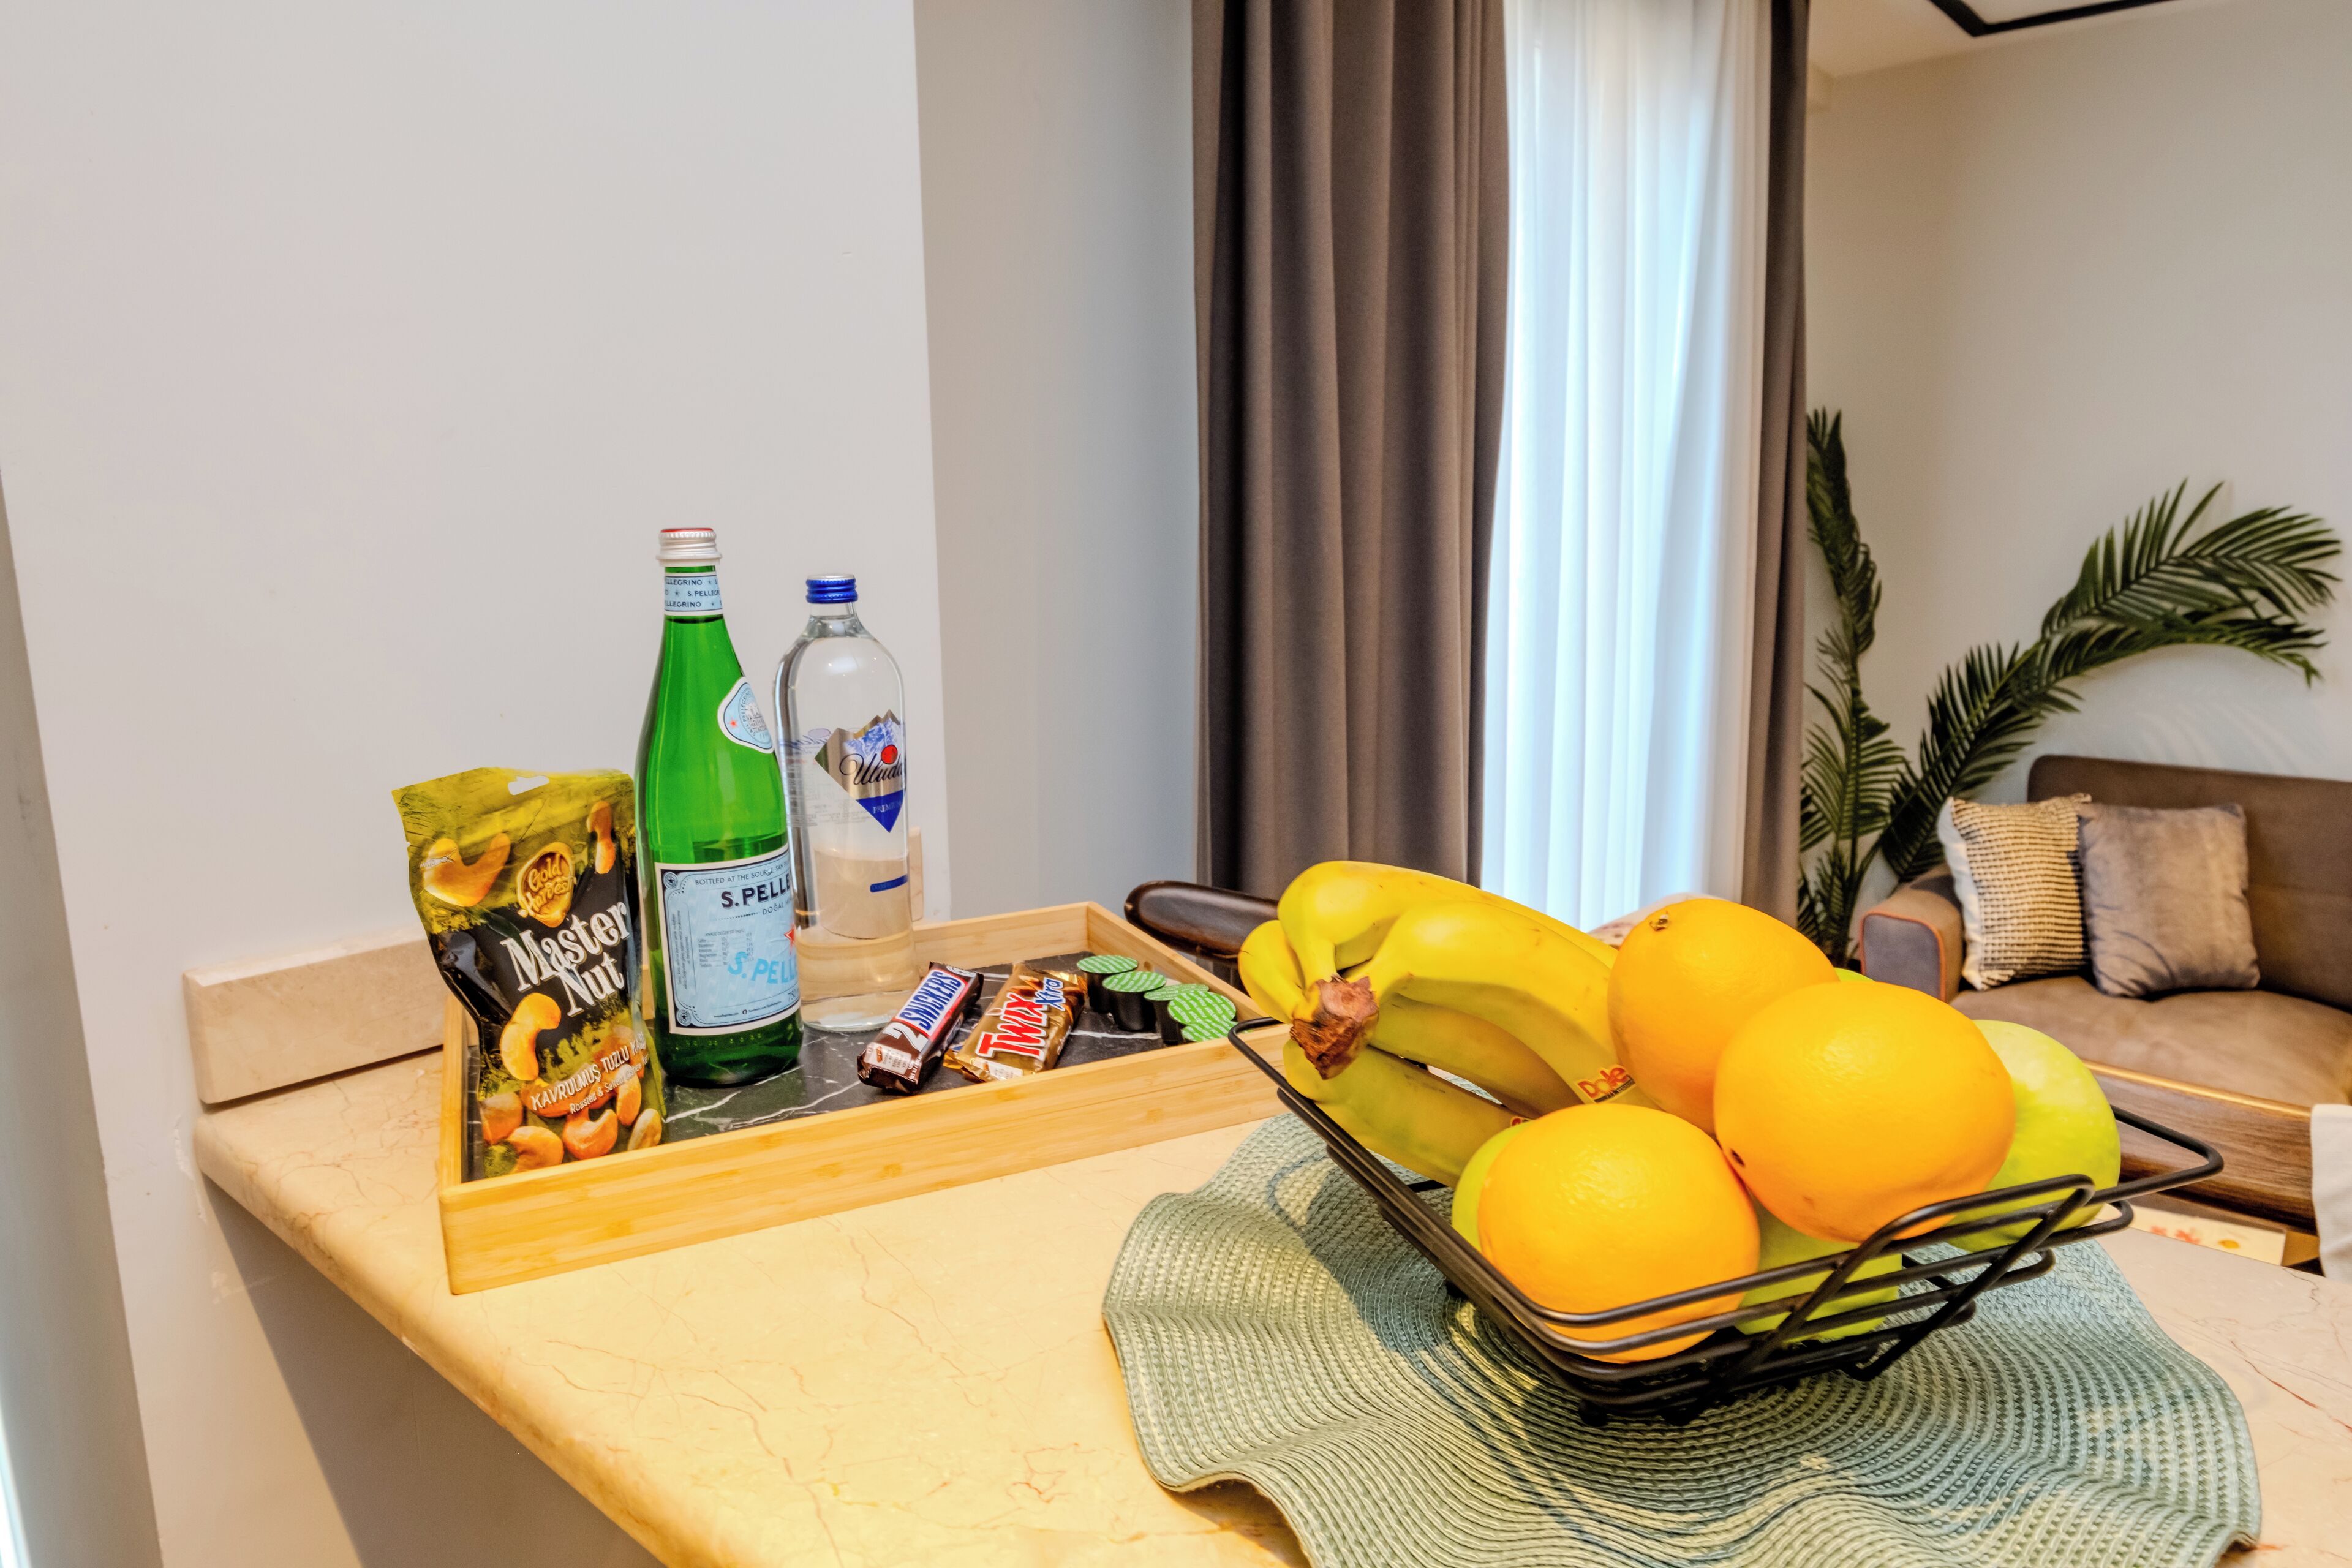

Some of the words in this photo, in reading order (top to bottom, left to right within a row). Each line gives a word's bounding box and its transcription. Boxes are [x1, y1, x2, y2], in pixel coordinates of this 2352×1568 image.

[839, 753, 904, 786] Uluda
[528, 853, 562, 892] Gold
[763, 903, 784, 915] DOĞAL
[500, 902, 630, 993] Master
[556, 952, 625, 1017] Nut
[727, 951, 797, 984] S.PELL
[899, 971, 962, 1031] SNICKERS
[976, 993, 1047, 1060] TWIX
[1035, 978, 1065, 1011] Xtra
[883, 1022, 929, 1052] 2
[530, 1063, 601, 1111] KAVRULMUŞ
[600, 1045, 630, 1074] TUZLU
[1577, 1067, 1627, 1099] Dole
[569, 1091, 597, 1114] Roasted
[597, 1087, 604, 1097] &
